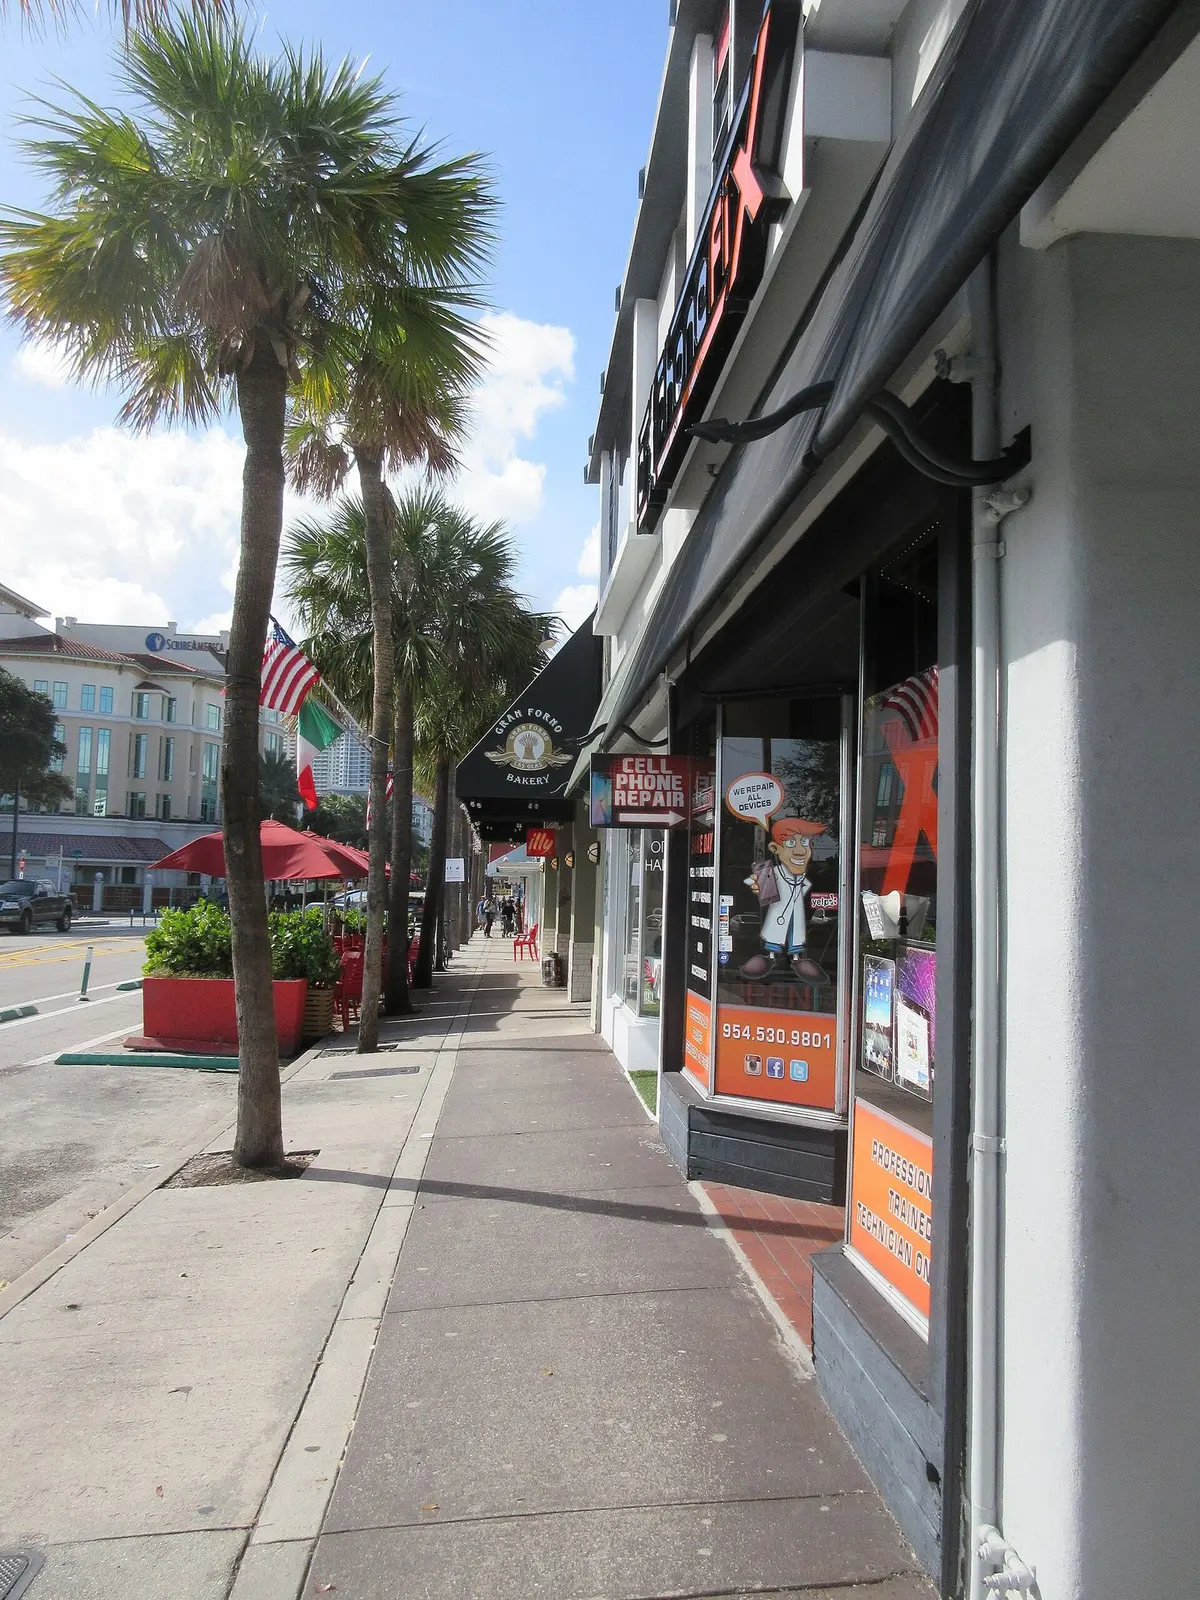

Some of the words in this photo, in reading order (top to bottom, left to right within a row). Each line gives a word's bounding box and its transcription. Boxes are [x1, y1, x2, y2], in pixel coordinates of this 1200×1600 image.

[495, 709, 523, 735] GRAN
[527, 708, 563, 733] FORNO
[509, 726, 527, 740] GRAN
[528, 724, 550, 741] FORNO
[622, 758, 673, 775] CELL
[506, 773, 550, 786] BAKERY
[616, 774, 683, 791] PHONE
[732, 787, 746, 796] WE
[746, 782, 775, 794] REPAIR
[747, 792, 762, 802] ALL
[614, 790, 685, 808] REPAIR
[738, 799, 772, 812] DEVICES
[528, 831, 554, 855] illy
[811, 897, 833, 908] yelp
[722, 1023, 831, 1049] 954.530.9801
[888, 1187, 932, 1243] TRAINED
[856, 1200, 913, 1269] TECHNICIAN
